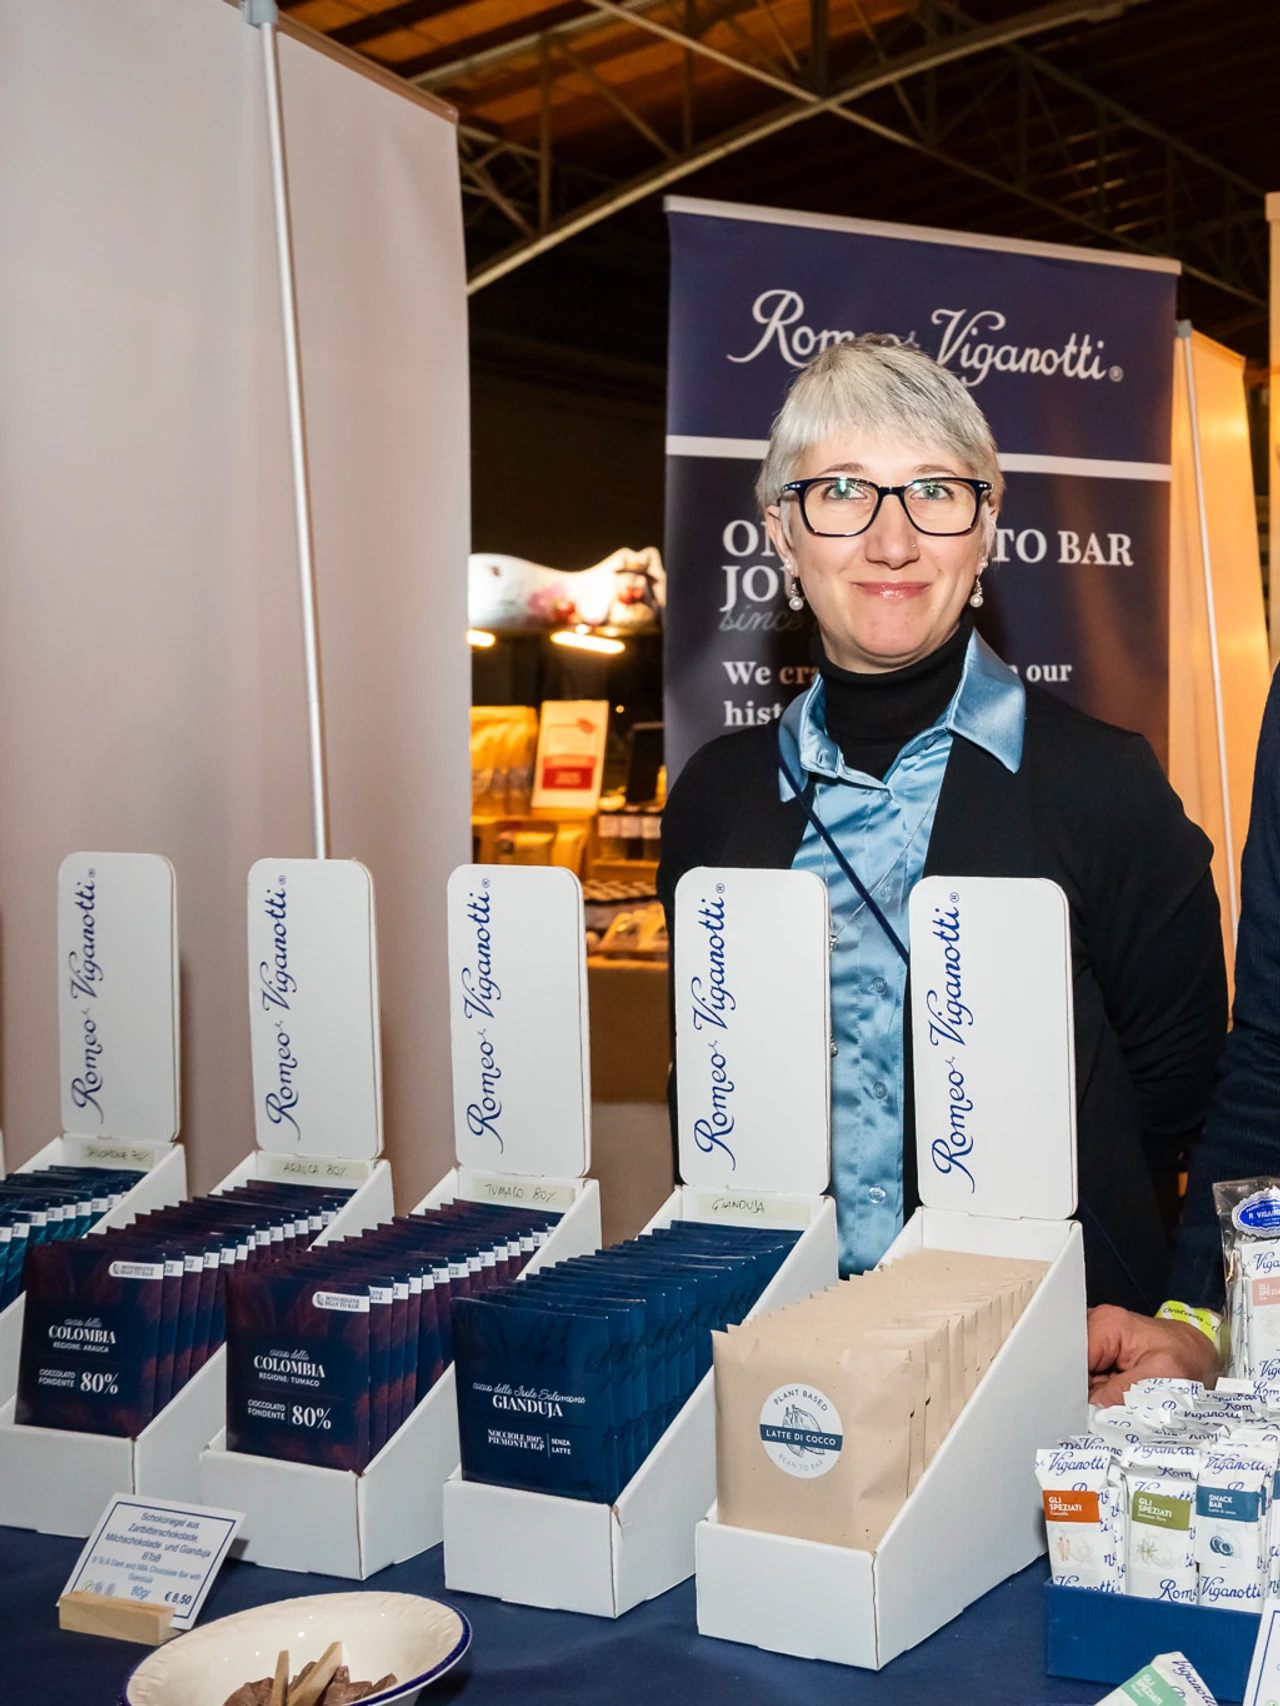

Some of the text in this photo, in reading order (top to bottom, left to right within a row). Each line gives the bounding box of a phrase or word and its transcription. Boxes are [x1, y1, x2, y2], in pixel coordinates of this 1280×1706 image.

[1057, 531, 1134, 567] BAR
[722, 661, 1073, 685] We our
[693, 1052, 737, 1172] Romeo
[931, 1070, 976, 1195] Romeo
[48, 1325, 117, 1345] COLOMBIA
[253, 1355, 326, 1379] COLOMBIA
[80, 1372, 119, 1395] 80%
[290, 1376, 320, 1388] TUMACO
[492, 1394, 564, 1419] GIANDUJA
[773, 1388, 828, 1412] PLANT BASED
[247, 1408, 286, 1421] FONDENTE
[291, 1405, 332, 1430] 80%
[551, 1438, 571, 1447] SENZA
[766, 1429, 836, 1446] LATTE DI COCCO
[551, 1446, 572, 1455] LATTE
[1048, 1452, 1108, 1477] Viganotti
[1048, 1496, 1063, 1504] GLI
[1049, 1502, 1083, 1512] SPEZIATI
[1139, 1497, 1153, 1506] GLI
[1208, 1494, 1233, 1504] SNACK
[1208, 1501, 1223, 1509] BAR
[1138, 1504, 1172, 1518] SPEZIATI
[140, 1512, 200, 1529] Schokoriegel aus
[105, 1532, 212, 1559] Milchschokolade und Gianduja
[1200, 1576, 1263, 1600] Viganotti
[171, 1591, 193, 1606] 8,50
